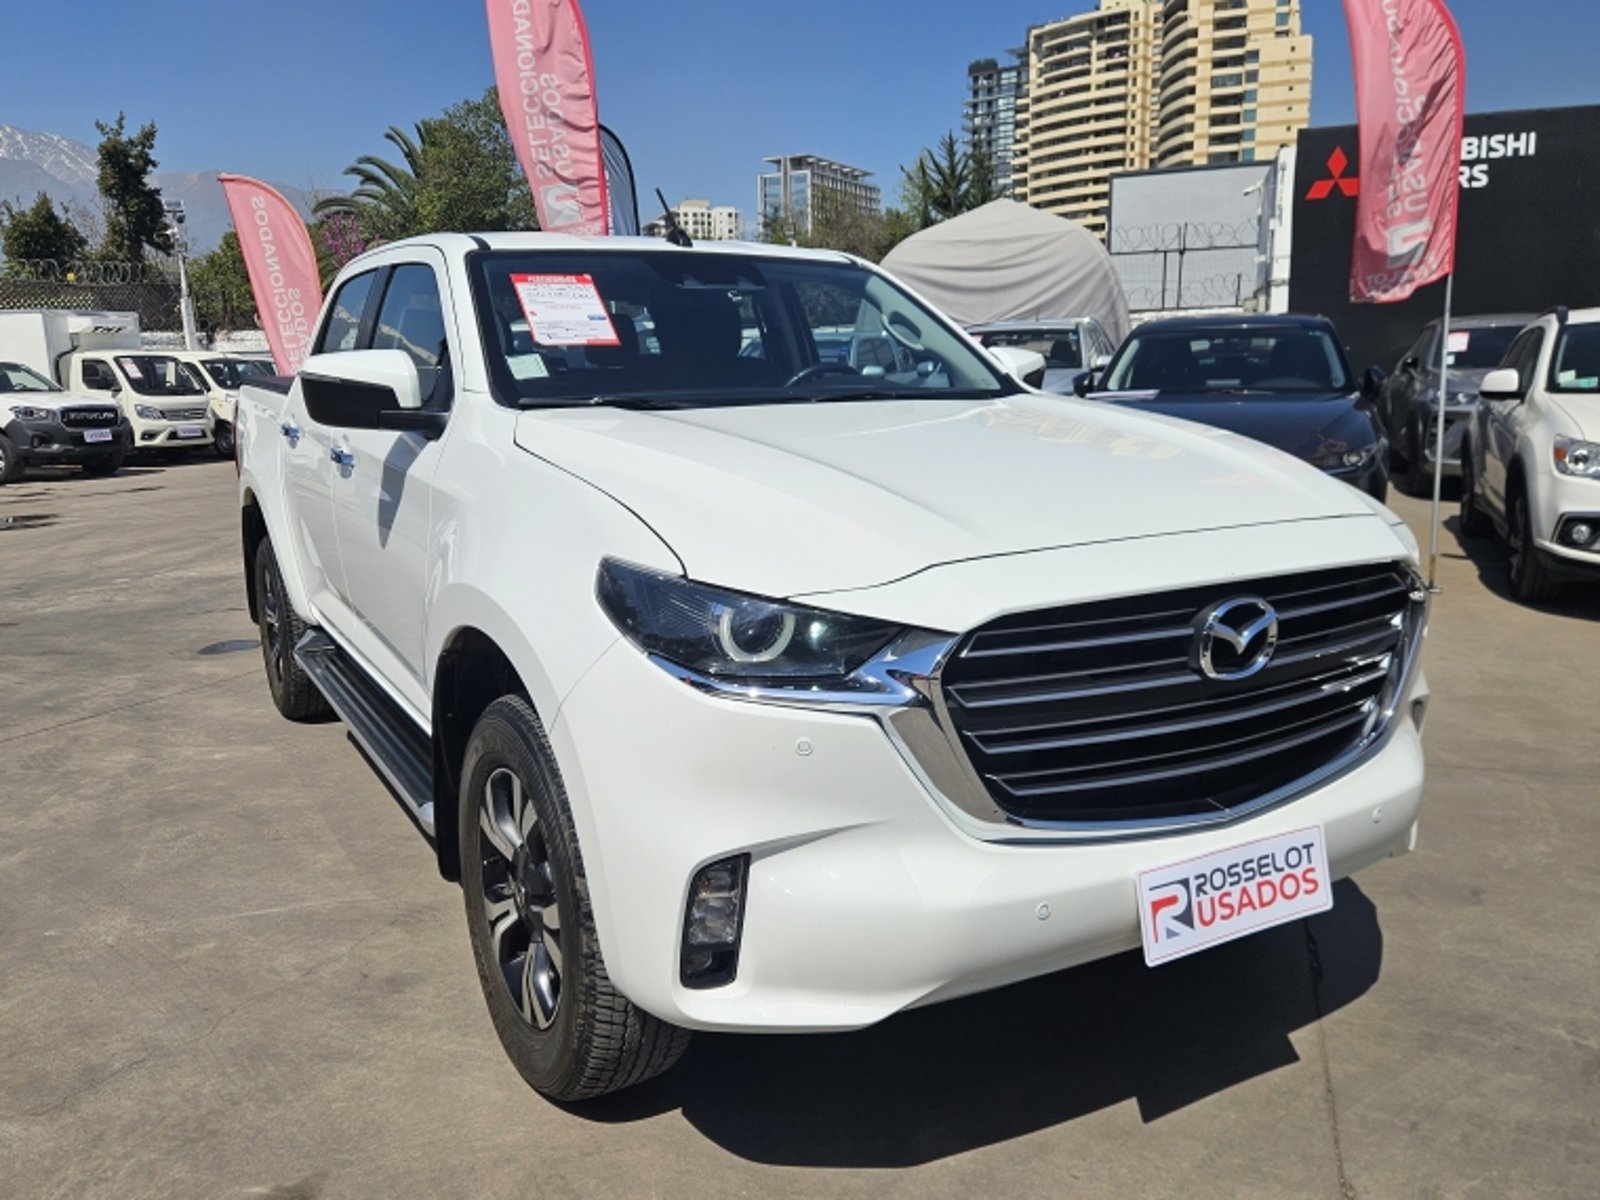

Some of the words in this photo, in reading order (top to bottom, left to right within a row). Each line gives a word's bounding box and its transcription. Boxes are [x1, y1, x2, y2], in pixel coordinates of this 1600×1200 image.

[1460, 131, 1537, 161] BISHI
[1194, 842, 1314, 897] ROSSELOT
[1197, 867, 1319, 927] USADOS
